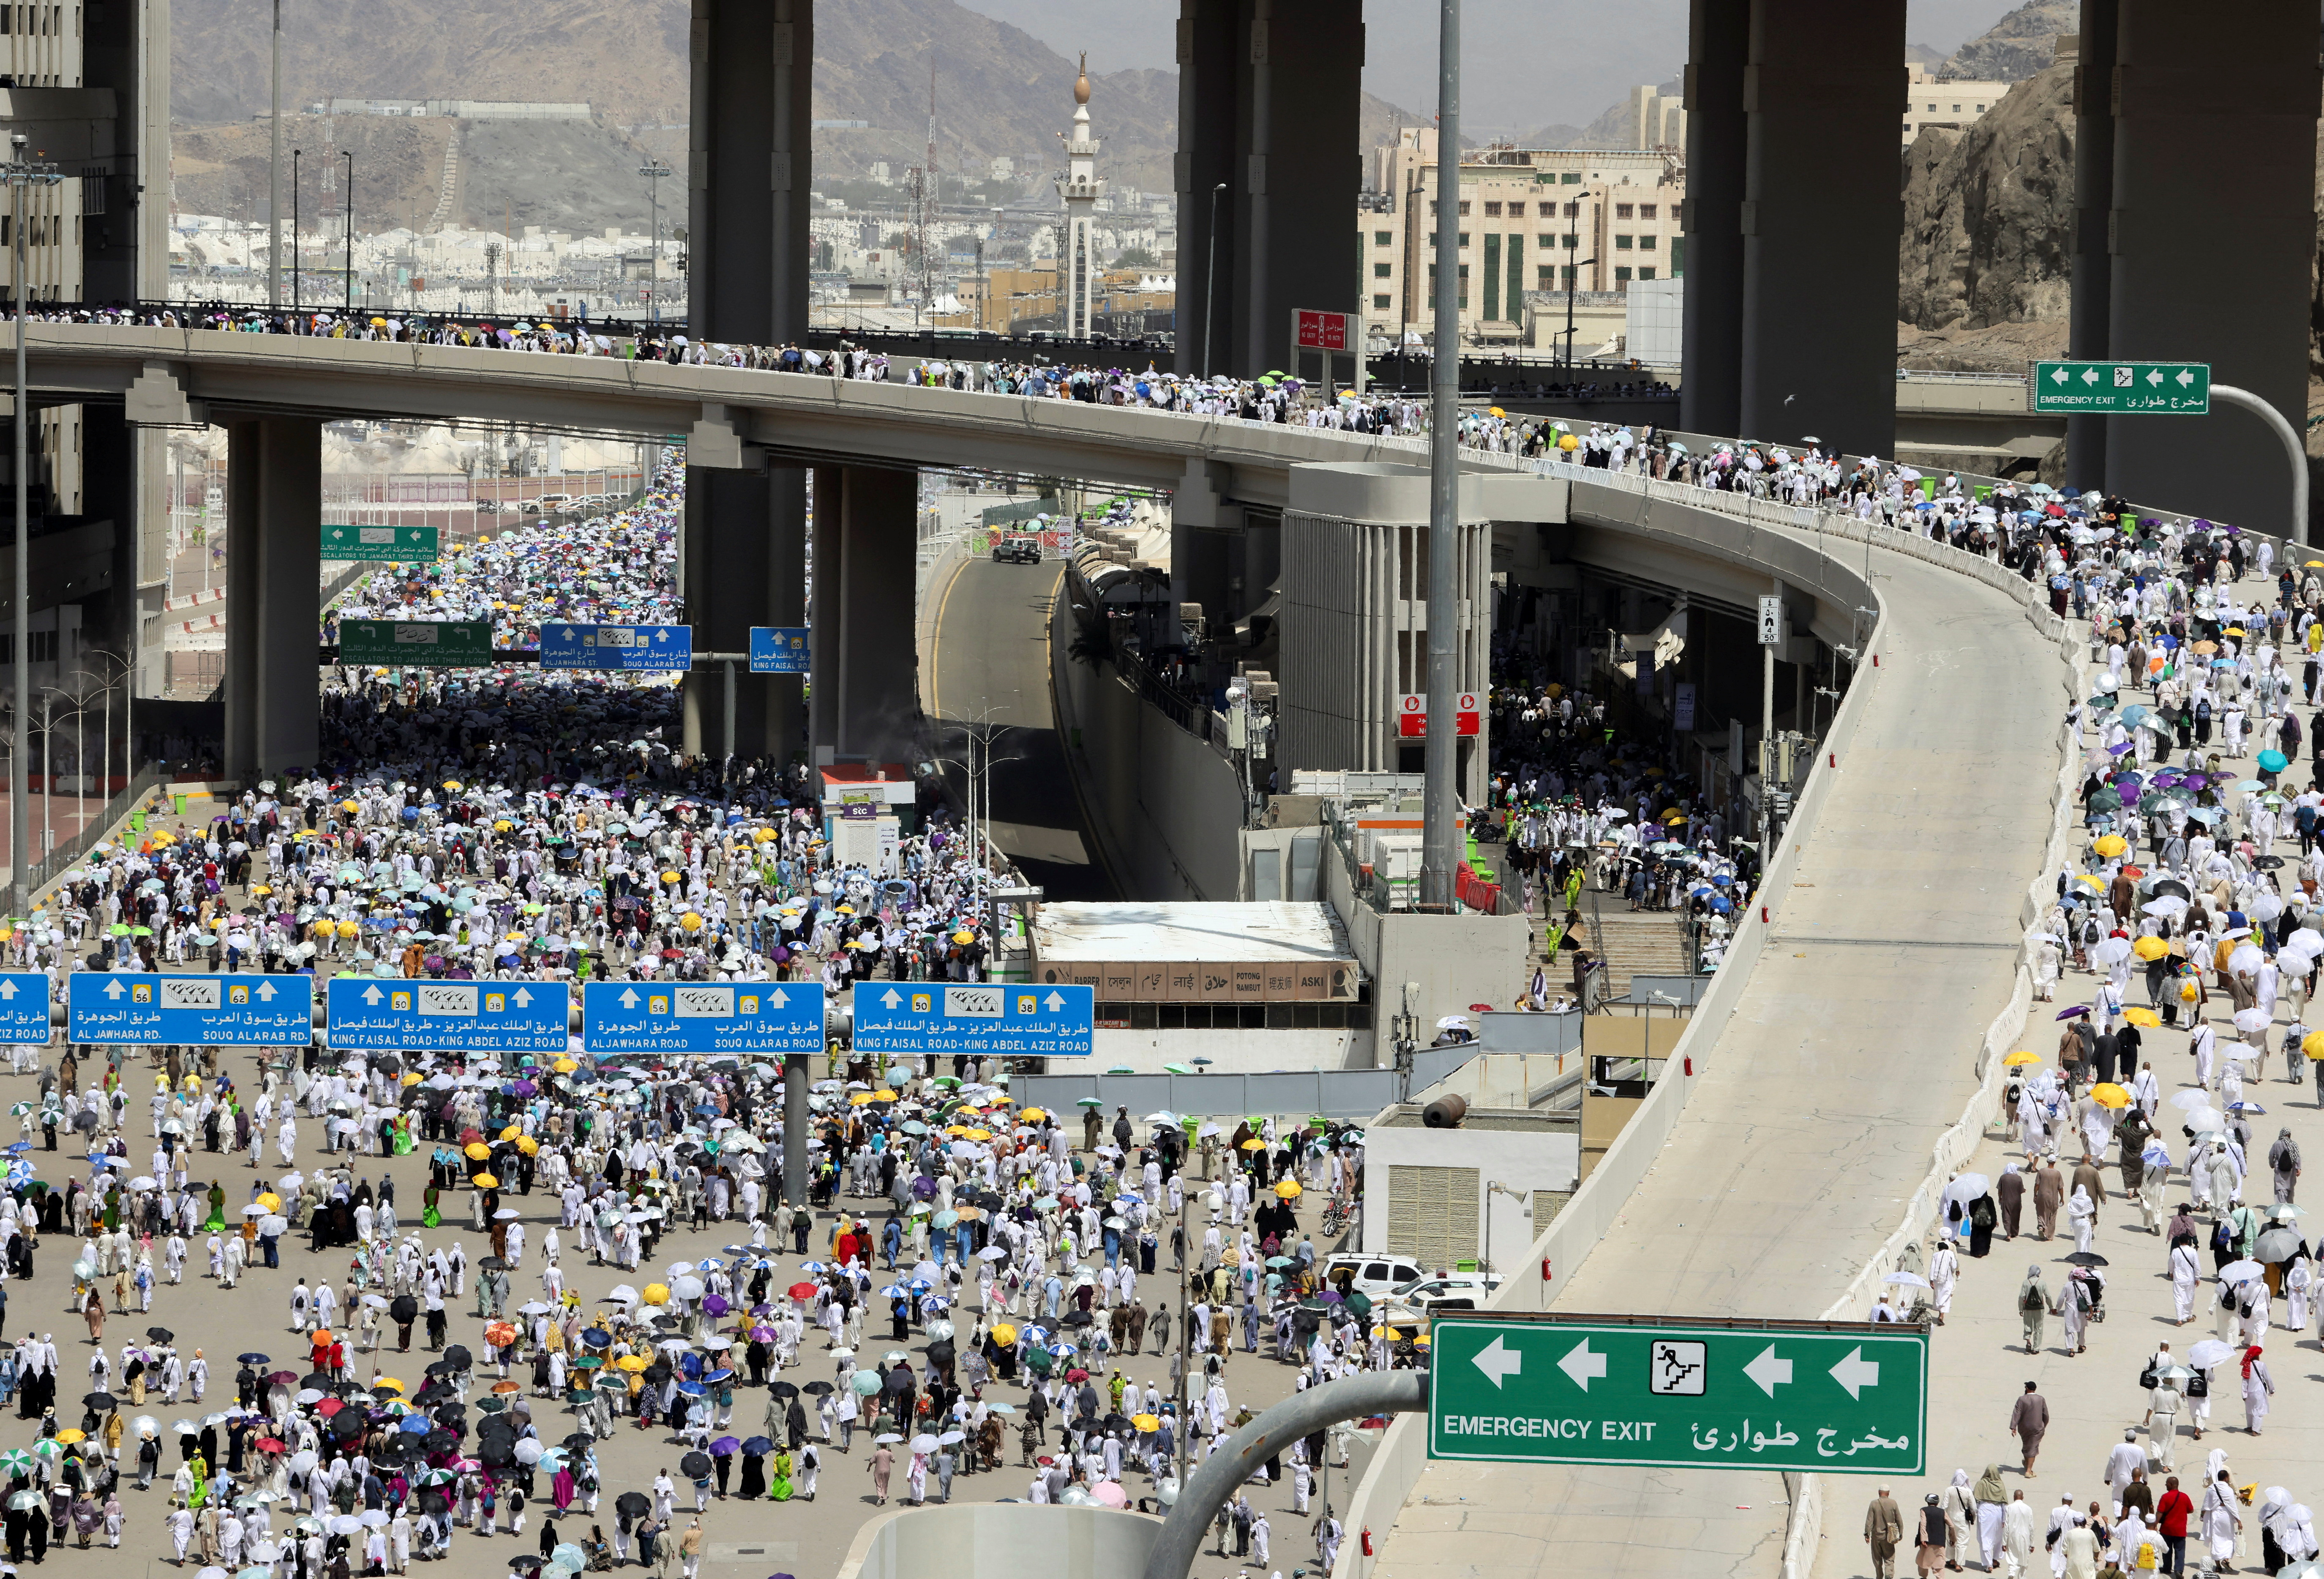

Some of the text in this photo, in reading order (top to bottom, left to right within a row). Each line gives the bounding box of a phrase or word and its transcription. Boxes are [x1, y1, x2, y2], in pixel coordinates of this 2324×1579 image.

[2127, 396, 2204, 408] مخرج طوارئ
[388, 645, 419, 654] الجمرات
[466, 646, 487, 656] سلالم
[545, 648, 596, 659] شارع الجوهرة
[669, 650, 687, 660] شارع
[777, 651, 796, 659] الملك
[754, 651, 775, 661] فيصل
[1075, 976, 1099, 987] BARBER
[1107, 977, 1132, 990] সেলুন
[1173, 975, 1195, 990] नाई
[1205, 975, 1228, 991] حلاق
[1269, 977, 1292, 991] 理发师
[1301, 977, 1323, 986] ASKI
[136, 993, 147, 1003] 56
[233, 995, 245, 1003] 62
[15, 1011, 46, 1024] طريق
[78, 1011, 161, 1024] طريق الجوهرة
[202, 1012, 308, 1026] طريق سوق العرب
[332, 1016, 367, 1030] فيصل
[369, 1018, 399, 1029] الملك
[402, 1019, 432, 1032] طريق
[501, 1020, 532, 1031] الملك
[534, 1021, 564, 1034] طريق
[598, 1020, 680, 1034] طريق الجوهرة
[715, 1020, 818, 1034] طريق سوق العرب
[858, 1018, 892, 1033] فيصل
[894, 1020, 925, 1031] الملك
[927, 1021, 957, 1034] طريق
[1026, 1022, 1056, 1033] الملك
[1058, 1023, 1088, 1036] طريق
[16, 1029, 45, 1039] ROAD
[77, 1030, 161, 1039] AL JAWHARA RD.
[203, 1031, 233, 1040] SOUQ
[291, 1032, 308, 1041] RD.
[332, 1035, 355, 1044] KING
[360, 1035, 398, 1045] FAISAL
[467, 1037, 501, 1046] ABDEL
[506, 1037, 531, 1046] AZIZ
[535, 1037, 564, 1047] ROAD
[661, 1039, 687, 1048] ROAD
[715, 1038, 742, 1048] SOUQ
[793, 1039, 819, 1048] ROAD
[857, 1038, 880, 1047] KING
[885, 1038, 923, 1048] FAISAL
[992, 1040, 1026, 1050] ABDEL
[1031, 1041, 1056, 1050] AZIZ
[1060, 1041, 1088, 1051] ROAD
[1445, 1415, 1656, 1440] EMERGENCY EXIT
[1691, 1418, 1909, 1456] مخرج طوارئ
